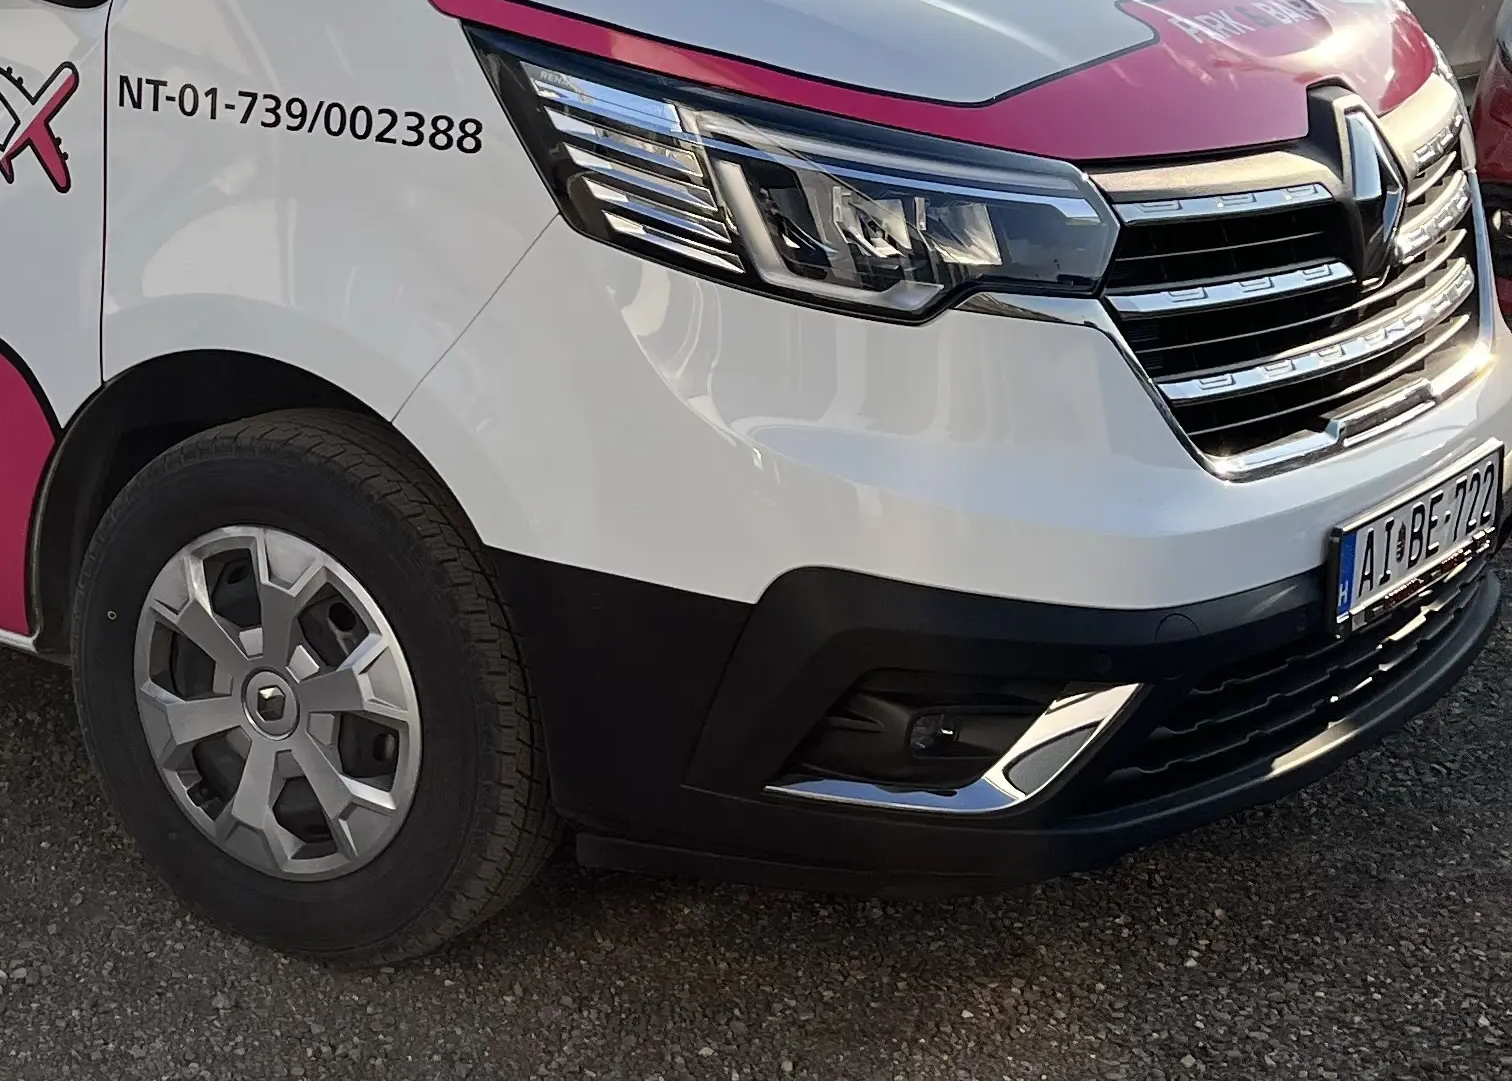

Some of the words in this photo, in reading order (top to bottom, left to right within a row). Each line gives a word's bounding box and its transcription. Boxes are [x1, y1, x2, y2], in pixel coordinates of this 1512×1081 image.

[117, 74, 484, 155] NT-01-739/002388
[1407, 461, 1496, 570] BE-722
[1338, 581, 1350, 607] H
